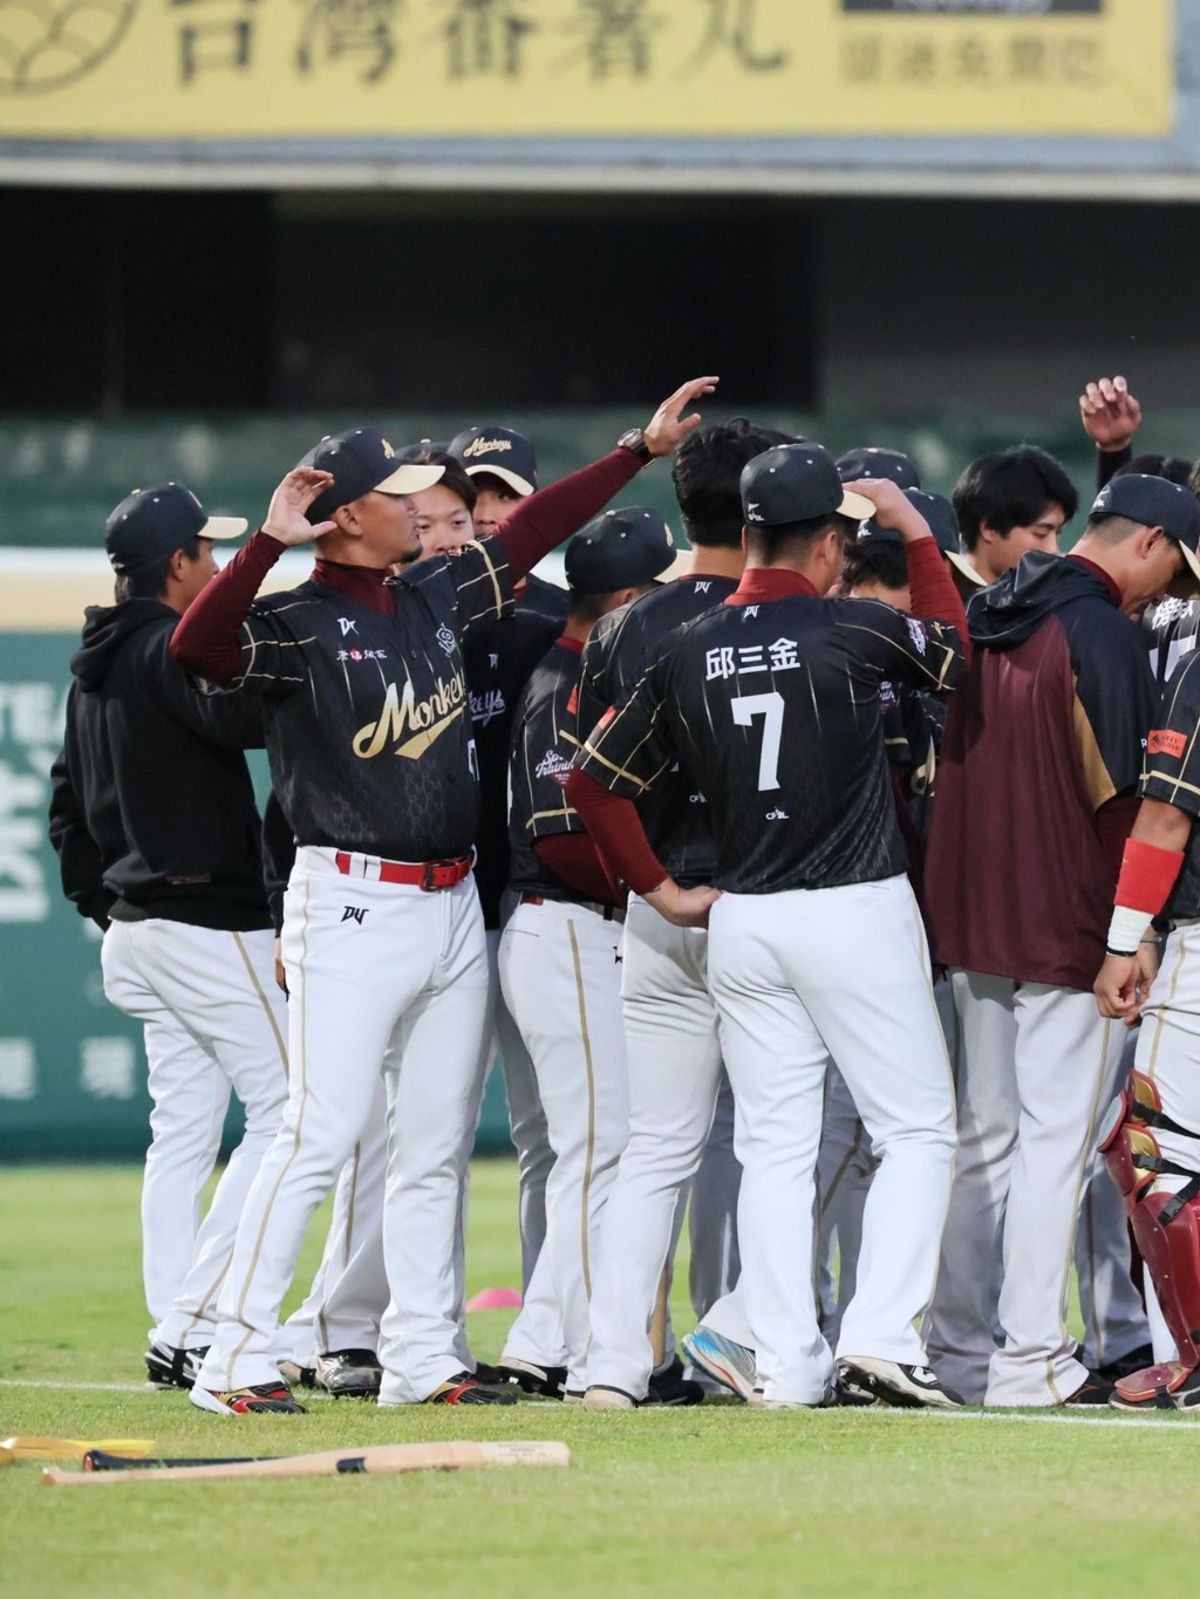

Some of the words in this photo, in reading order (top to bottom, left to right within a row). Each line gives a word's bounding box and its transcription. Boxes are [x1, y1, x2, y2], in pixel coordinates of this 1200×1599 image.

[706, 637, 801, 681] 邱三金
[730, 691, 785, 792] 7
